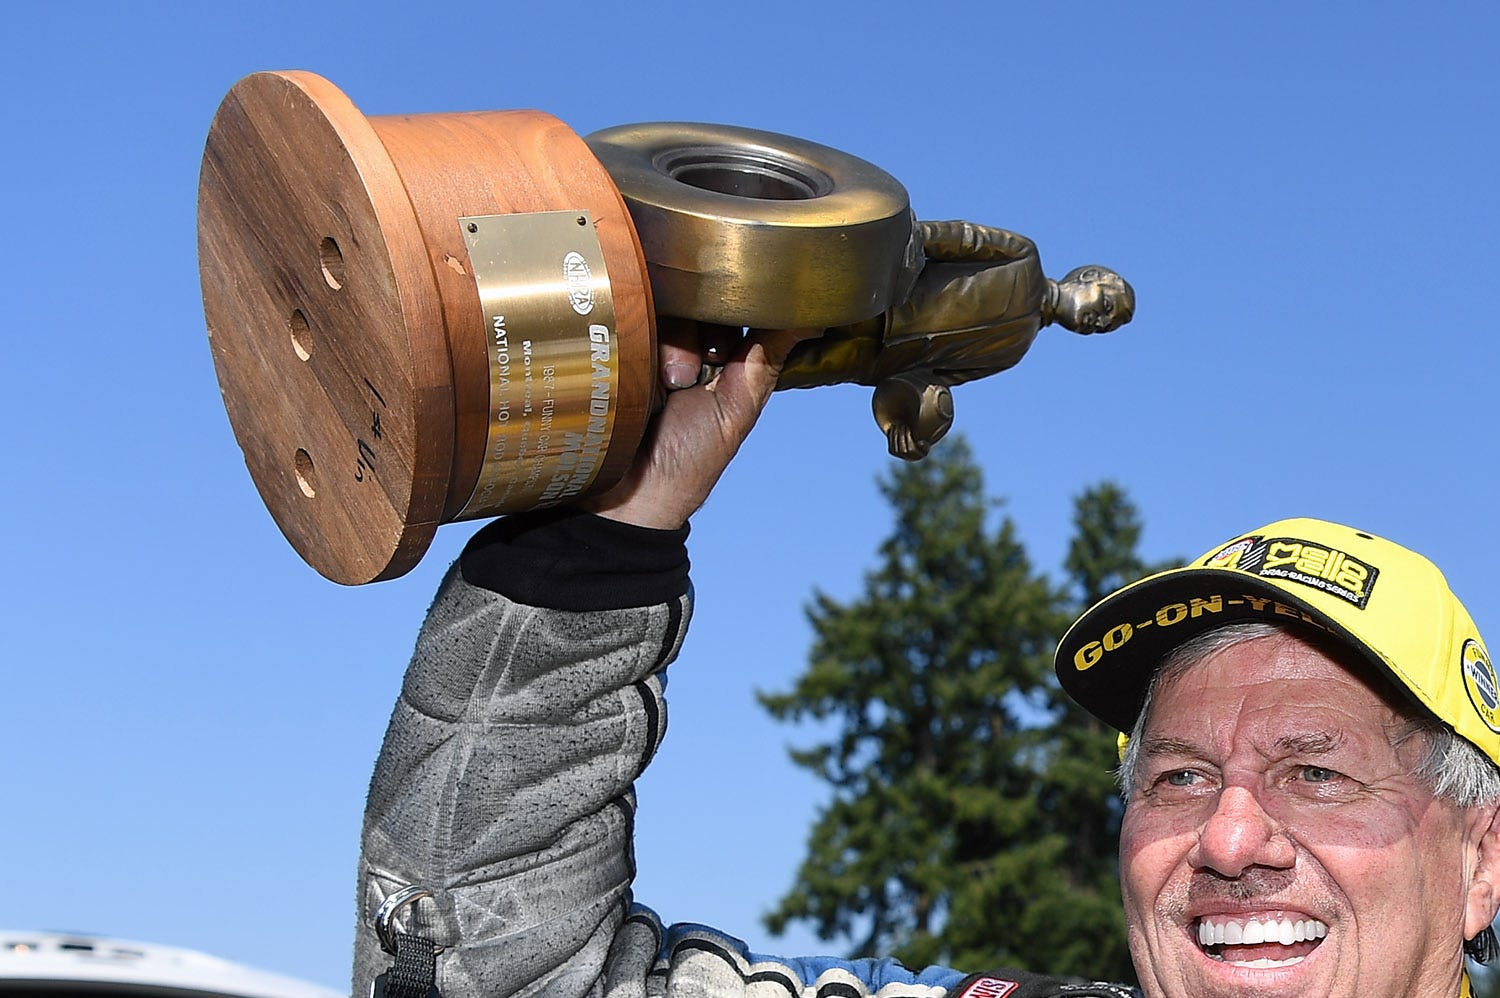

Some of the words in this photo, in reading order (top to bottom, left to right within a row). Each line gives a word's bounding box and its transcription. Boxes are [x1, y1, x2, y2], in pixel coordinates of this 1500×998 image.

[492, 315, 511, 395] NATIONAL
[1259, 568, 1290, 579] DRAG
[1288, 572, 1326, 590] RACING
